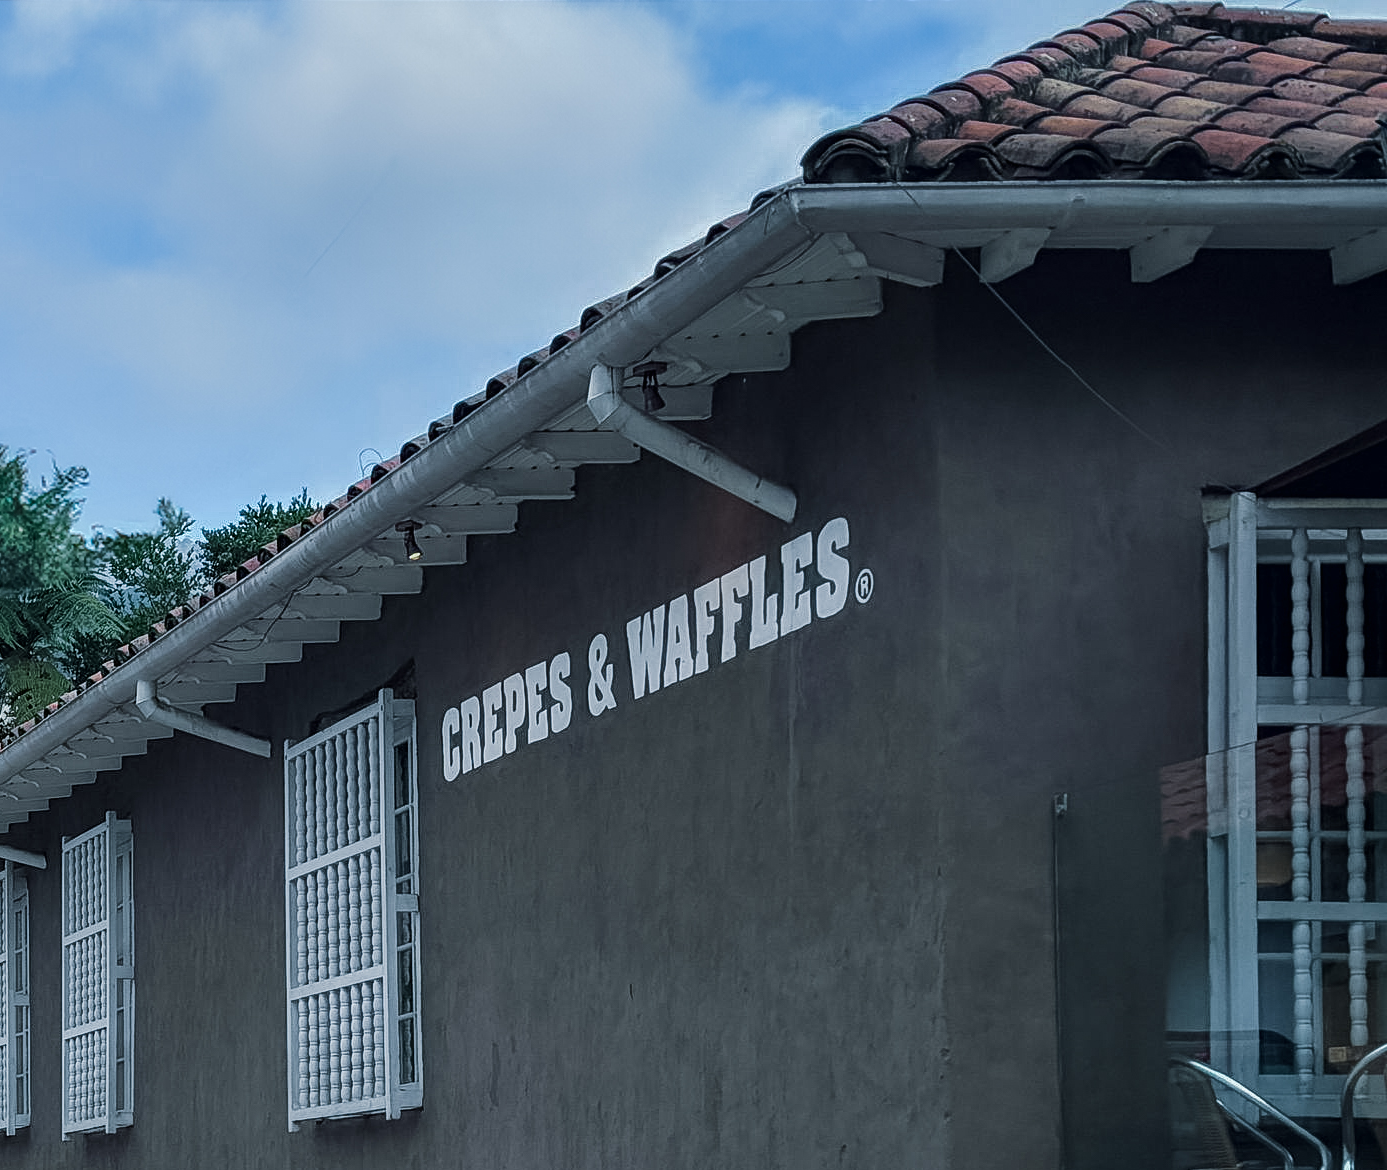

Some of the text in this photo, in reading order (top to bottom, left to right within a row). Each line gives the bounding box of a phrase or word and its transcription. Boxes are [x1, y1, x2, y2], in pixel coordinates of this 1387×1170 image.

[441, 651, 573, 782] CREPES
[587, 633, 617, 717] &
[626, 516, 850, 700] WAFFLES
